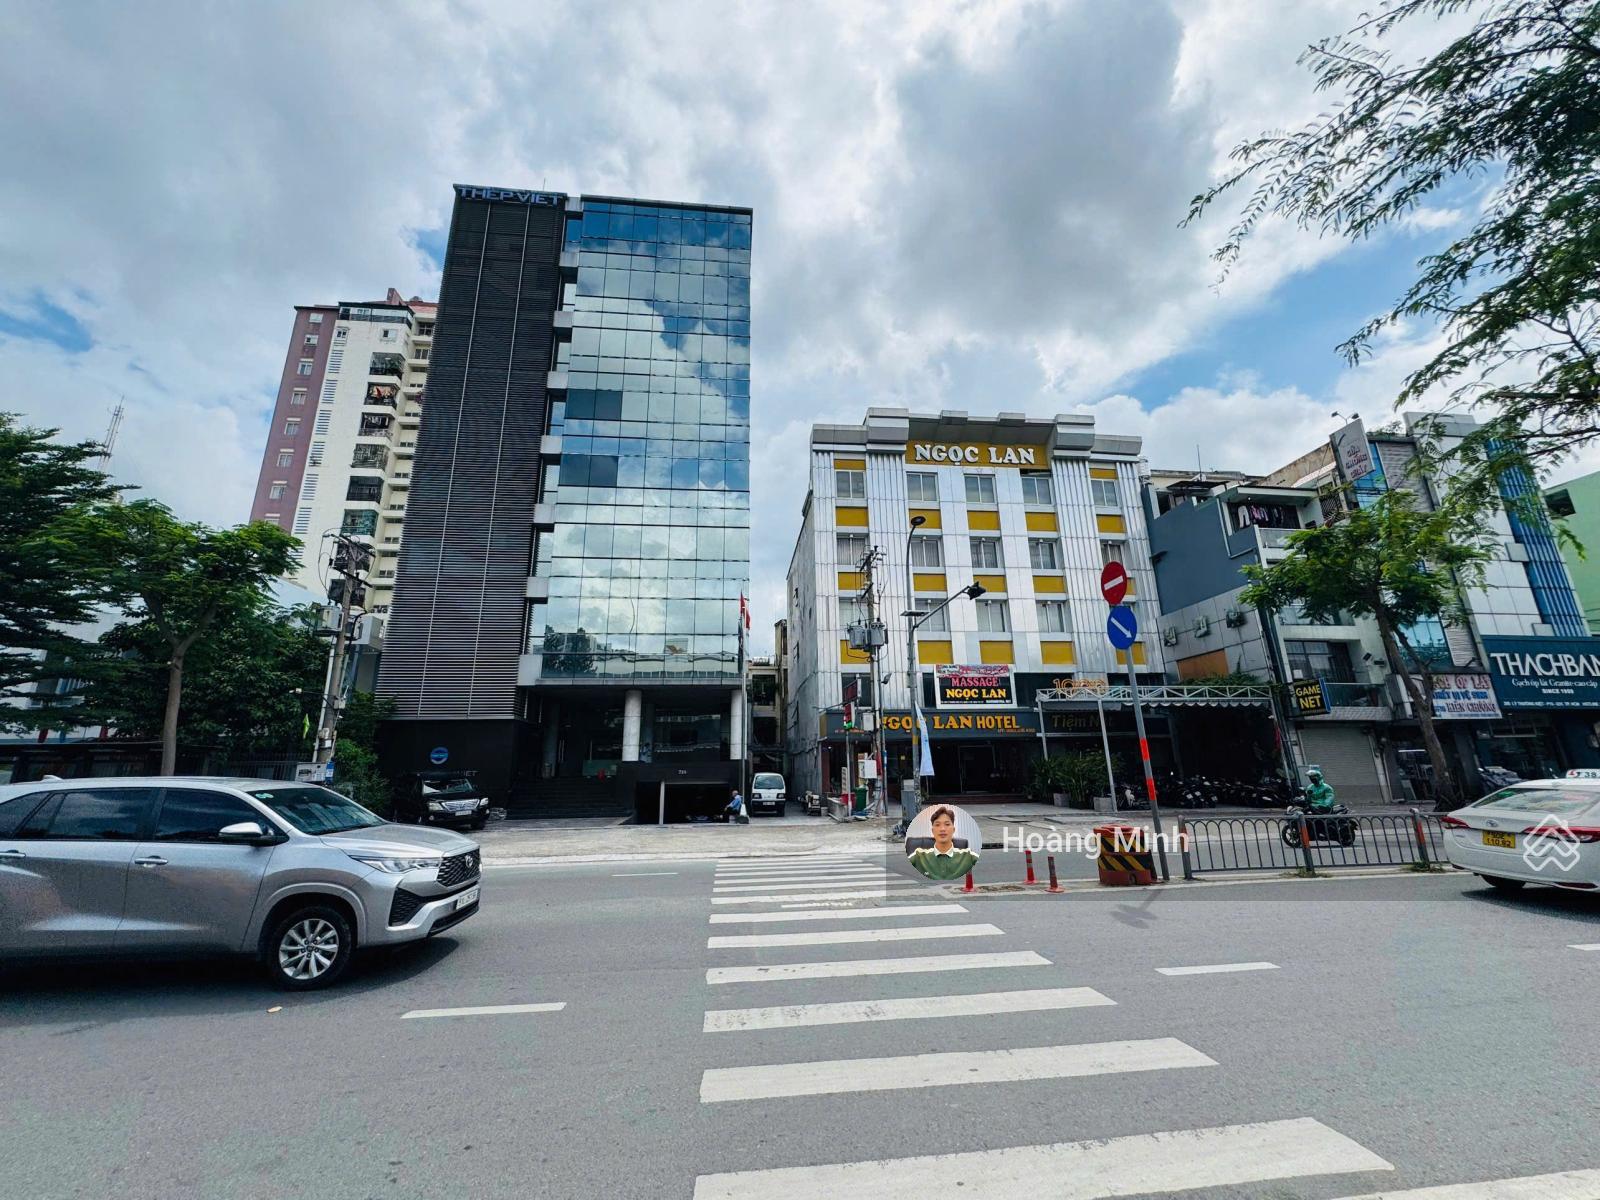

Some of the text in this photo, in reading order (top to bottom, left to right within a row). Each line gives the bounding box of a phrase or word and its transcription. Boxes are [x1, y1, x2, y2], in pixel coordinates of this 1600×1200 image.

[914, 444, 1035, 465] NGỌC LAN
[951, 676, 999, 687] MASSAGE
[945, 688, 1007, 700] NGỌC LAN
[1295, 684, 1321, 696] GAME
[1299, 695, 1321, 709] NET
[932, 715, 973, 729] LAN
[975, 715, 1020, 729] HOTEL
